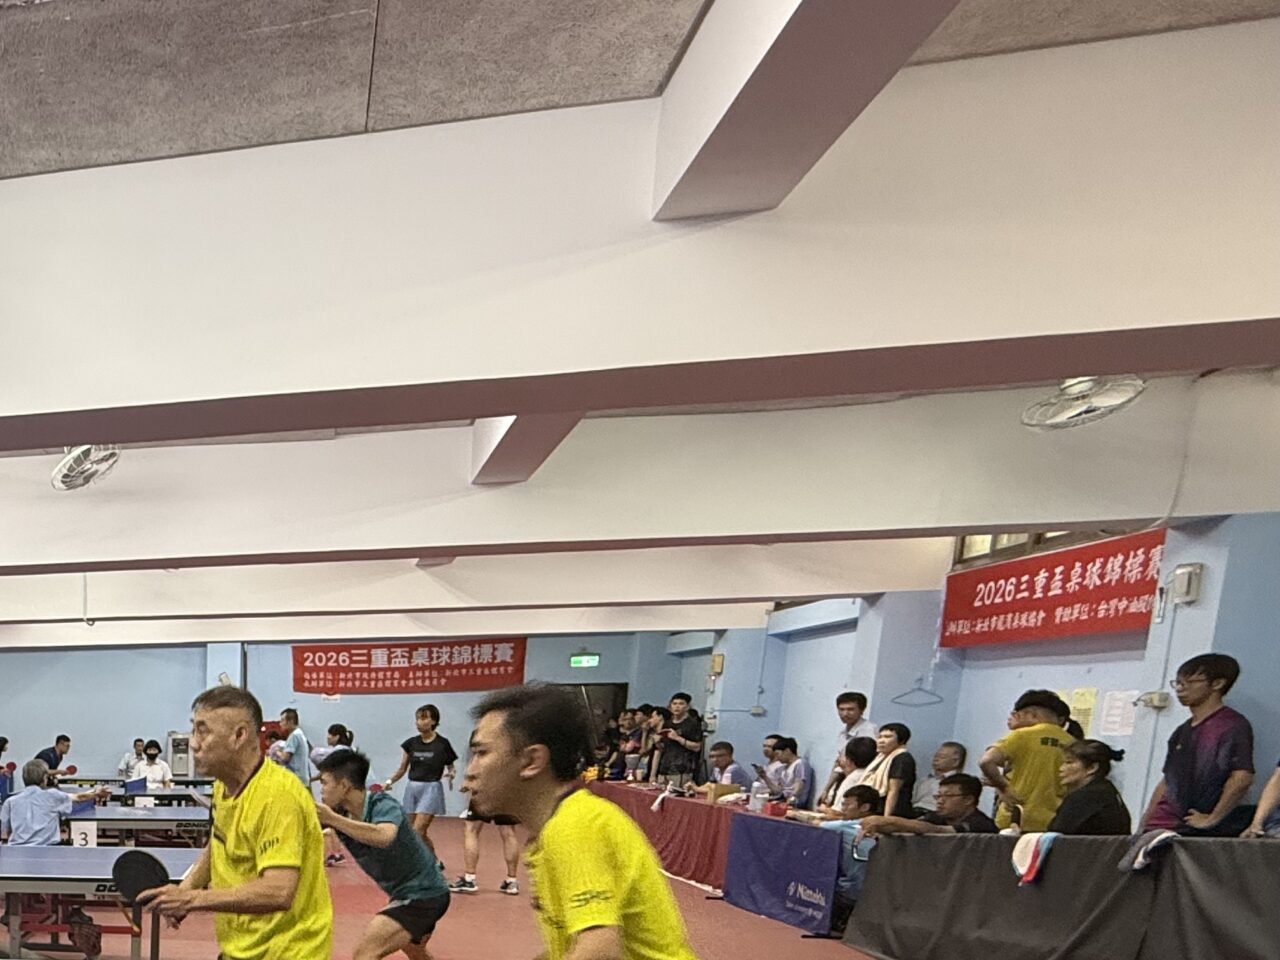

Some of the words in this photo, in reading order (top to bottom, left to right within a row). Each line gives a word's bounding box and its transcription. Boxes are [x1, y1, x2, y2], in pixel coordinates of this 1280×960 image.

[303, 643, 514, 668] 2026三重盃桌球錦標賽
[78, 831, 89, 847] 3
